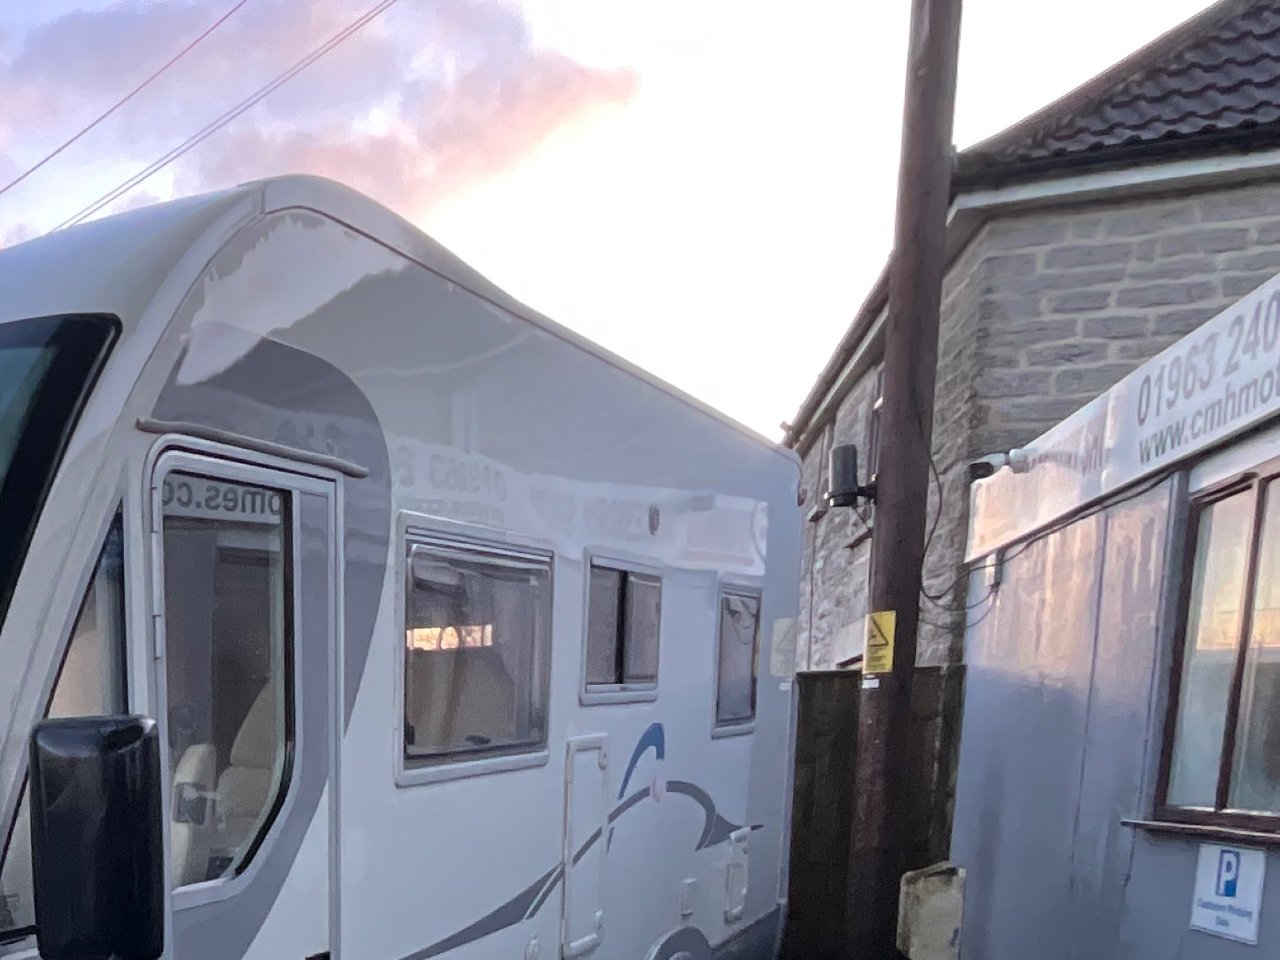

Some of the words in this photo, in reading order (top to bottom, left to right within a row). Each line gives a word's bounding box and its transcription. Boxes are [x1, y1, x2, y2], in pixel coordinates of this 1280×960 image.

[1136, 332, 1219, 427] 01963
[1138, 354, 1280, 465] www.cmhmo
[1218, 851, 1238, 896] P
